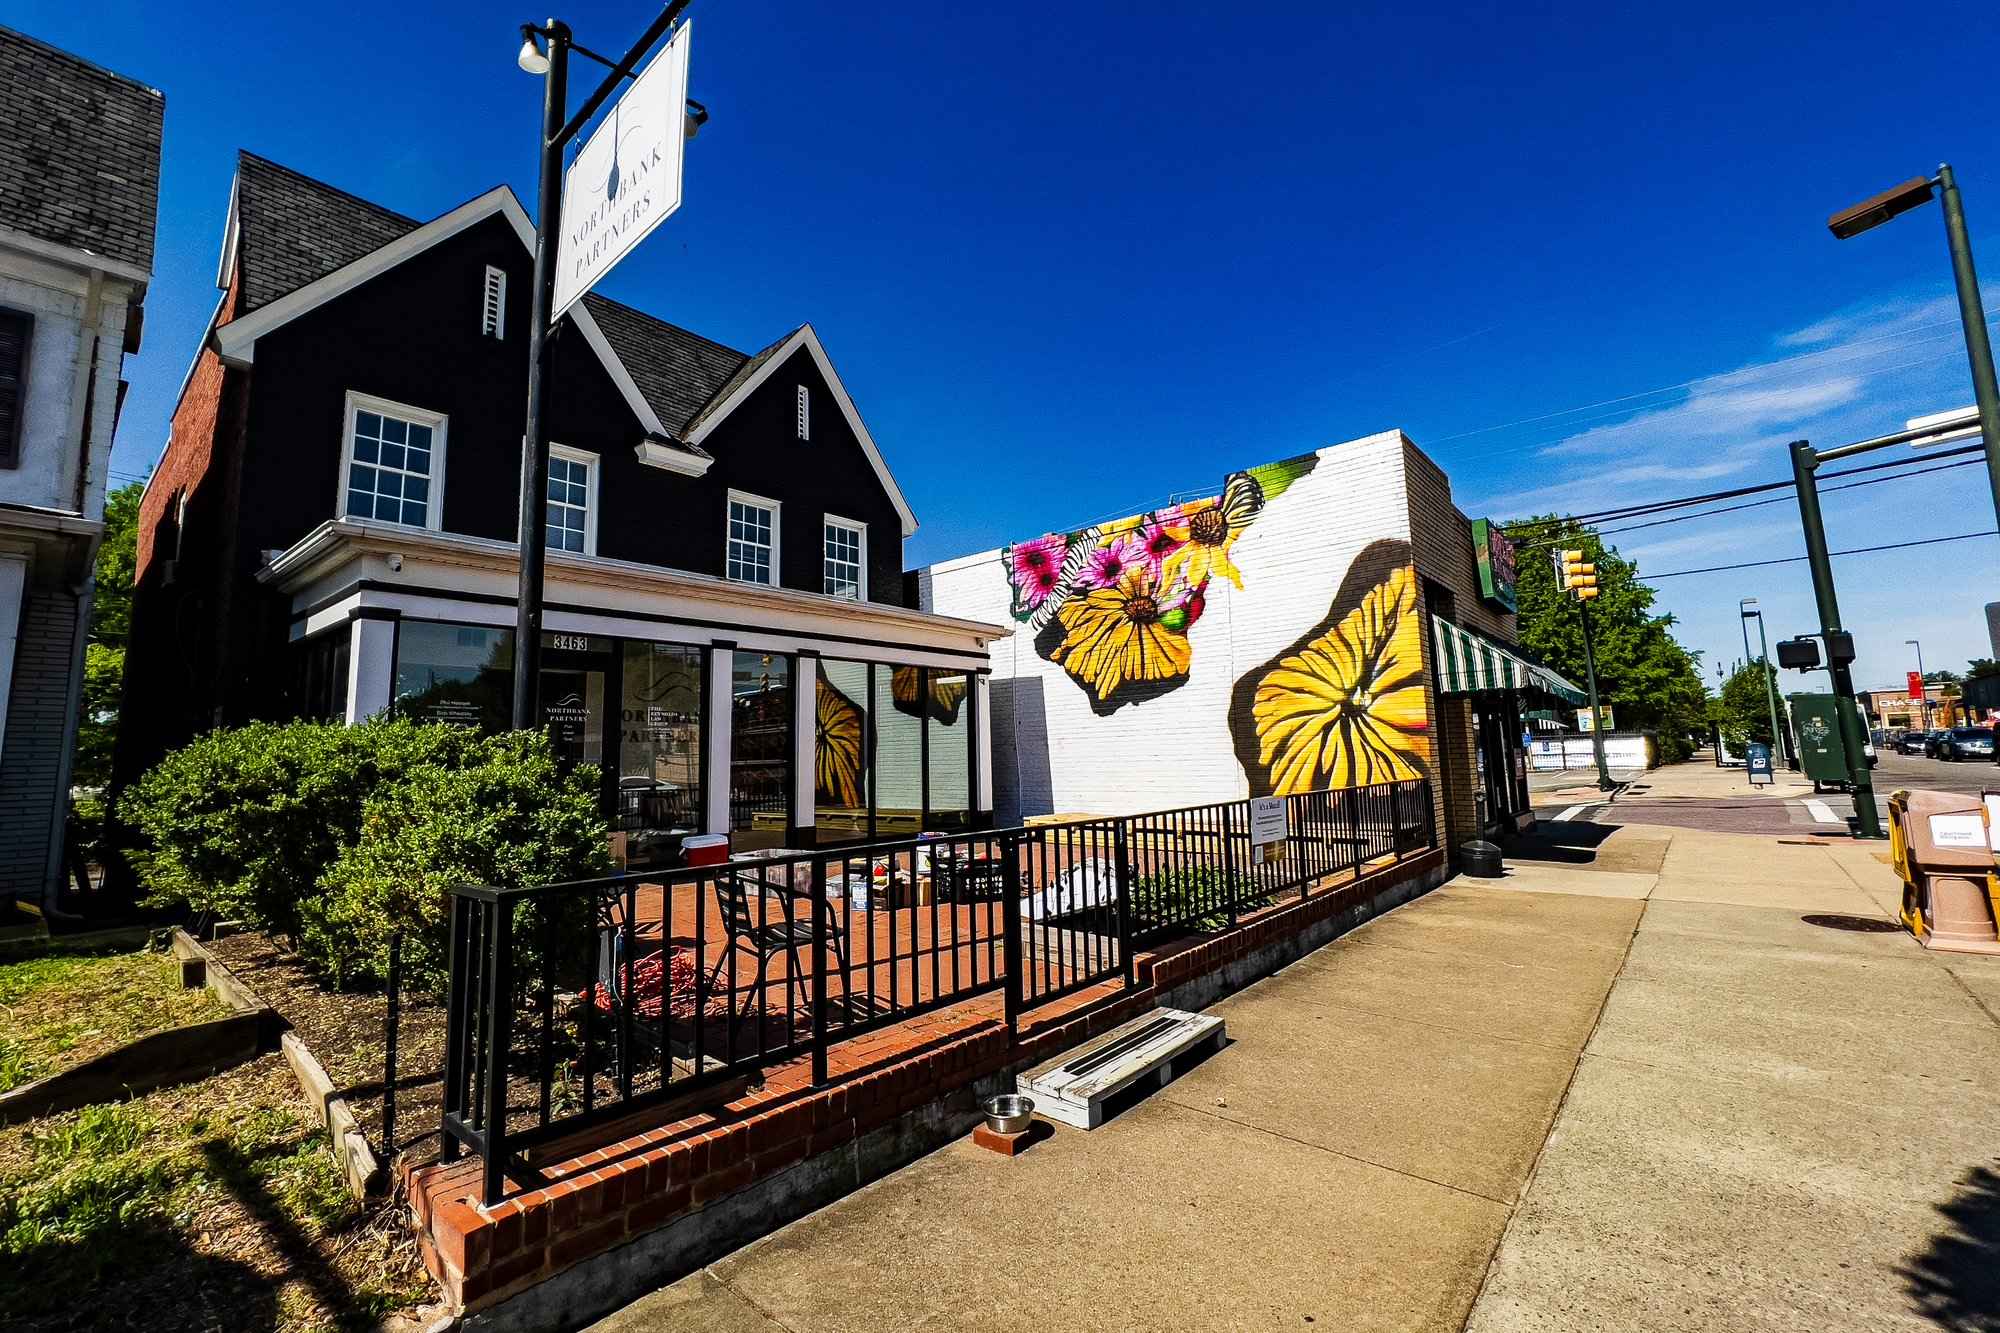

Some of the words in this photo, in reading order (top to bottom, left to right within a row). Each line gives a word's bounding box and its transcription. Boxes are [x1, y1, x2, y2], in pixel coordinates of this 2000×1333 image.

[575, 189, 650, 279] PARTNERS
[553, 633, 586, 650] 3463
[1879, 699, 1921, 707] CHASE
